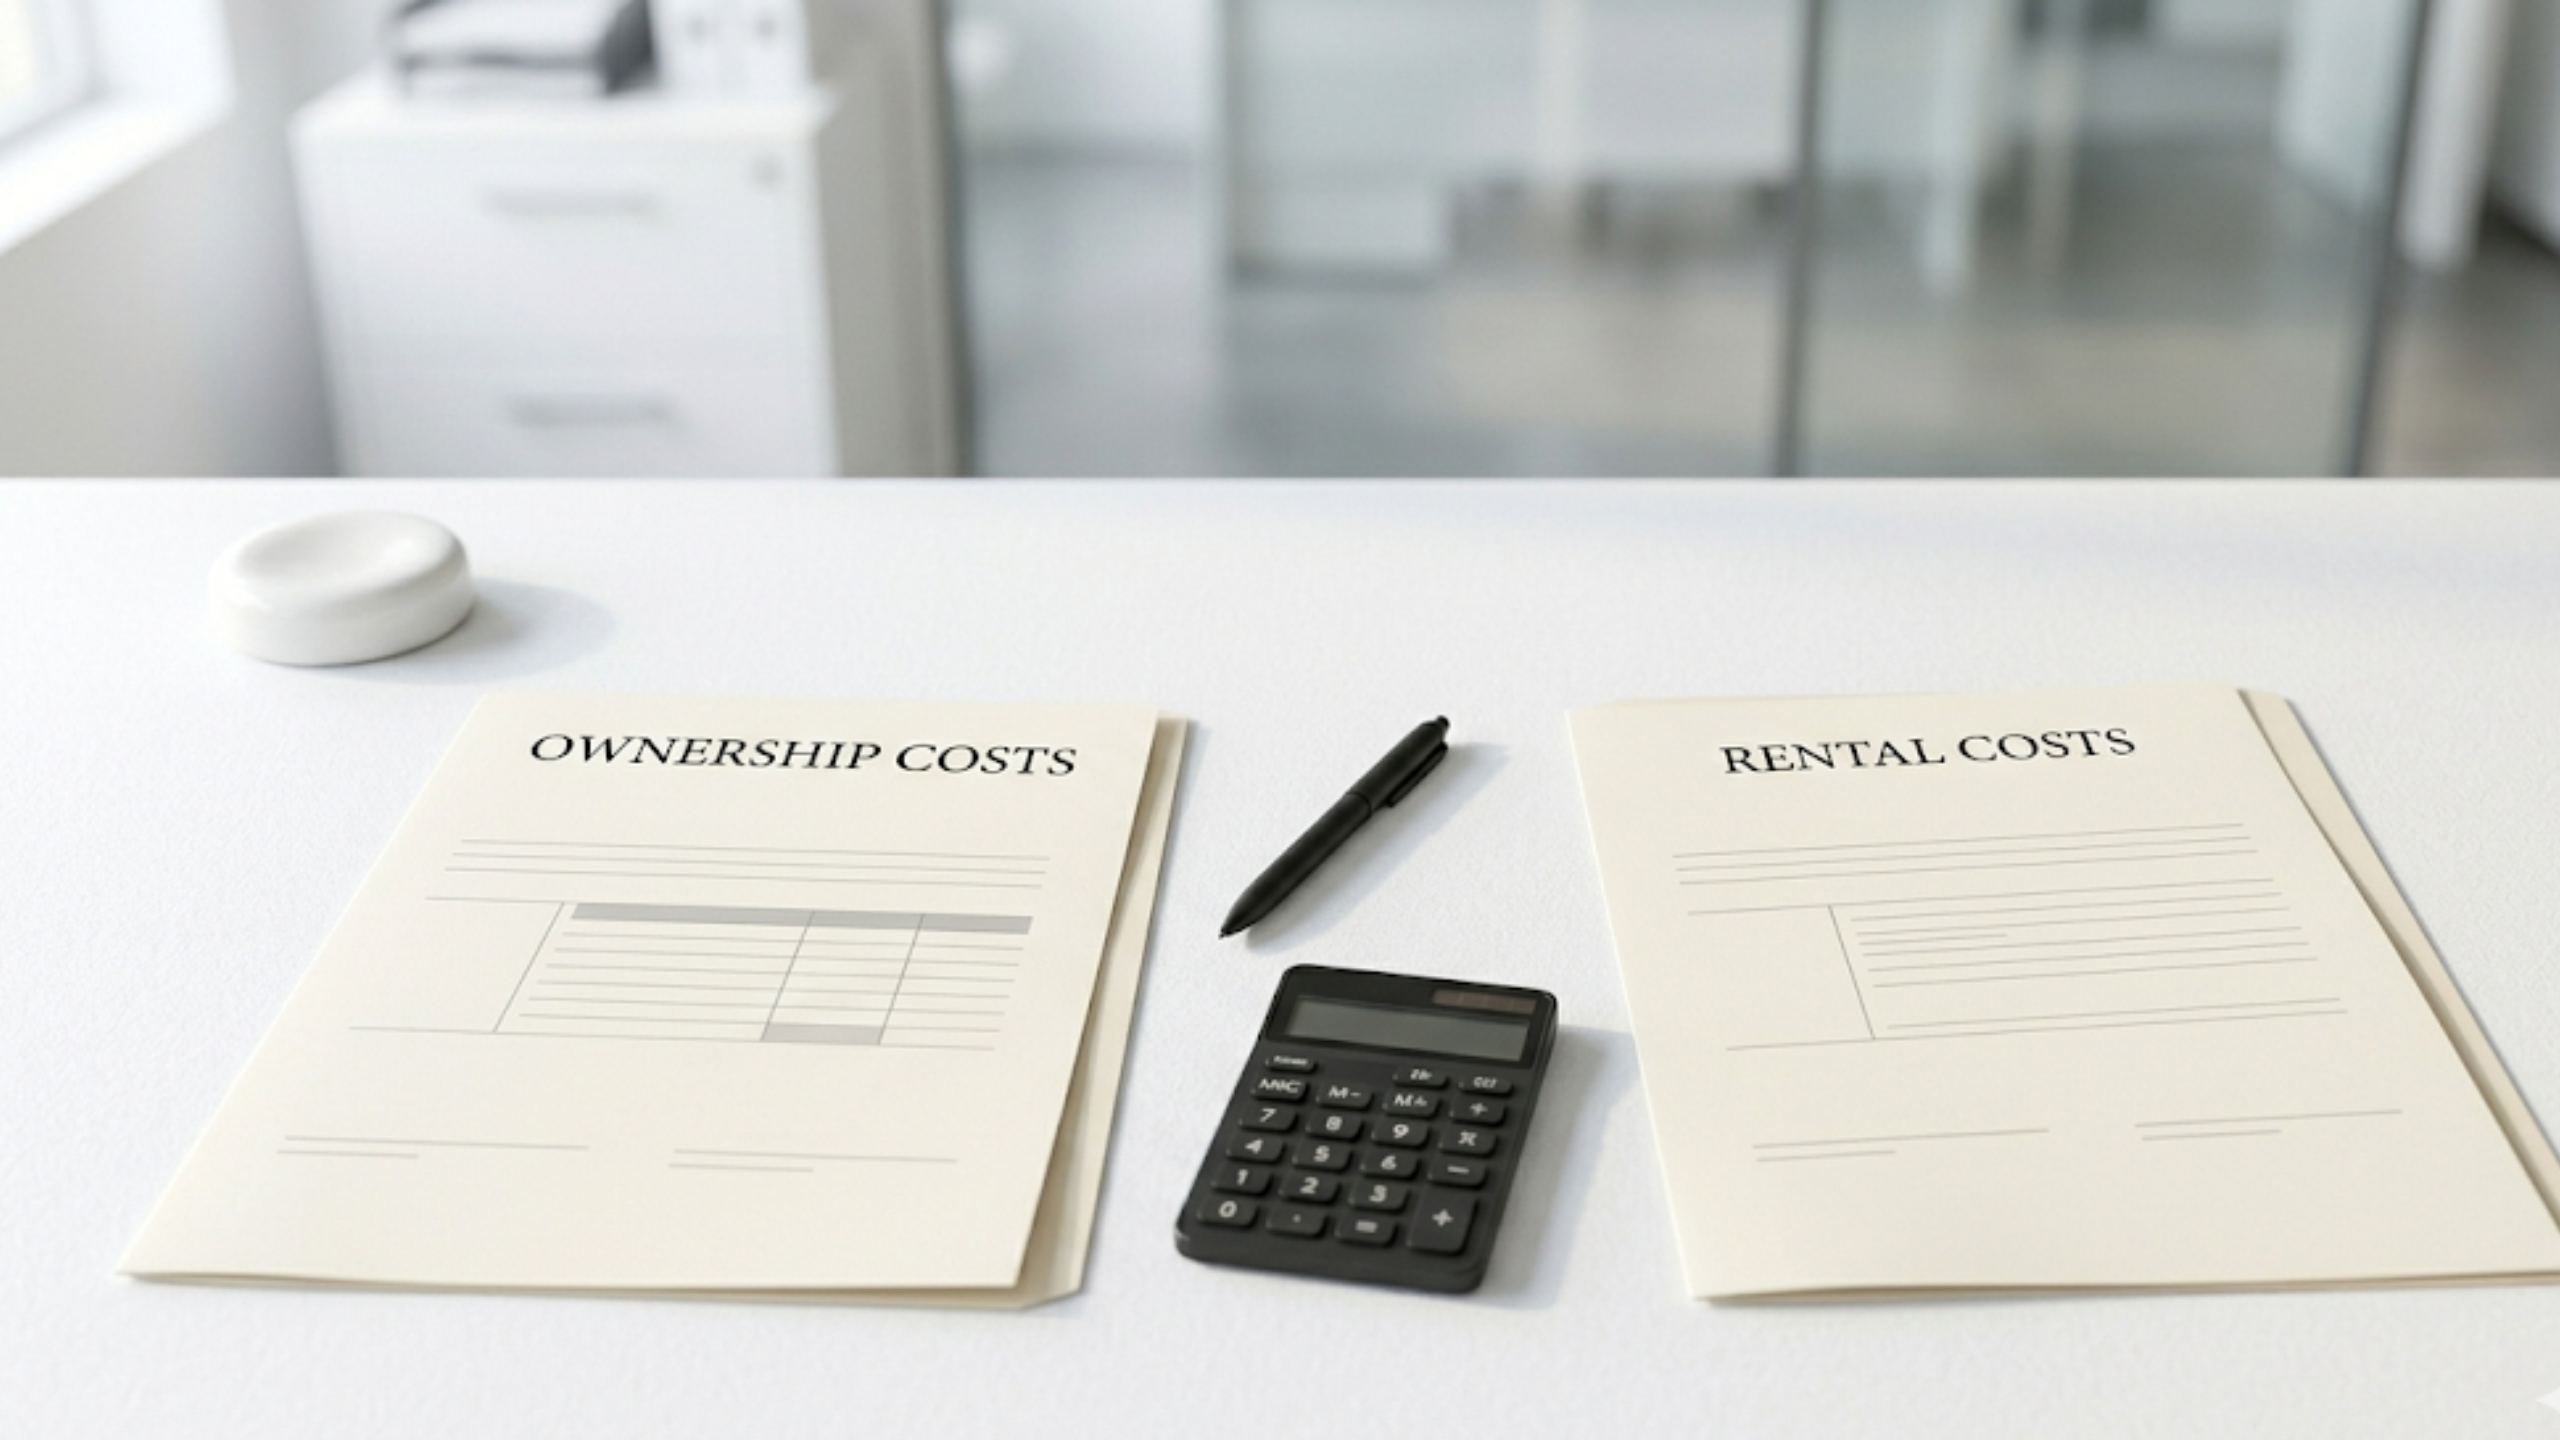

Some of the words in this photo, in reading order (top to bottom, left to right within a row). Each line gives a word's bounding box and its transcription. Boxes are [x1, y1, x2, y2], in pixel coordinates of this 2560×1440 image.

[530, 734, 882, 770] OWNERSHIP
[895, 744, 1077, 775] COSTS
[1719, 738, 1946, 774] RENTAL
[1957, 728, 2136, 762] COSTS
[1260, 1107, 1277, 1122] 7
[1325, 1115, 1343, 1131] 8
[1392, 1123, 1410, 1139] 9
[1245, 1138, 1264, 1154] 4
[1313, 1145, 1330, 1162] 5
[1380, 1154, 1397, 1170] 6
[1236, 1169, 1249, 1185] 1
[1300, 1176, 1319, 1194] 2
[1369, 1184, 1388, 1202] 3
[1218, 1200, 1238, 1218] 0
